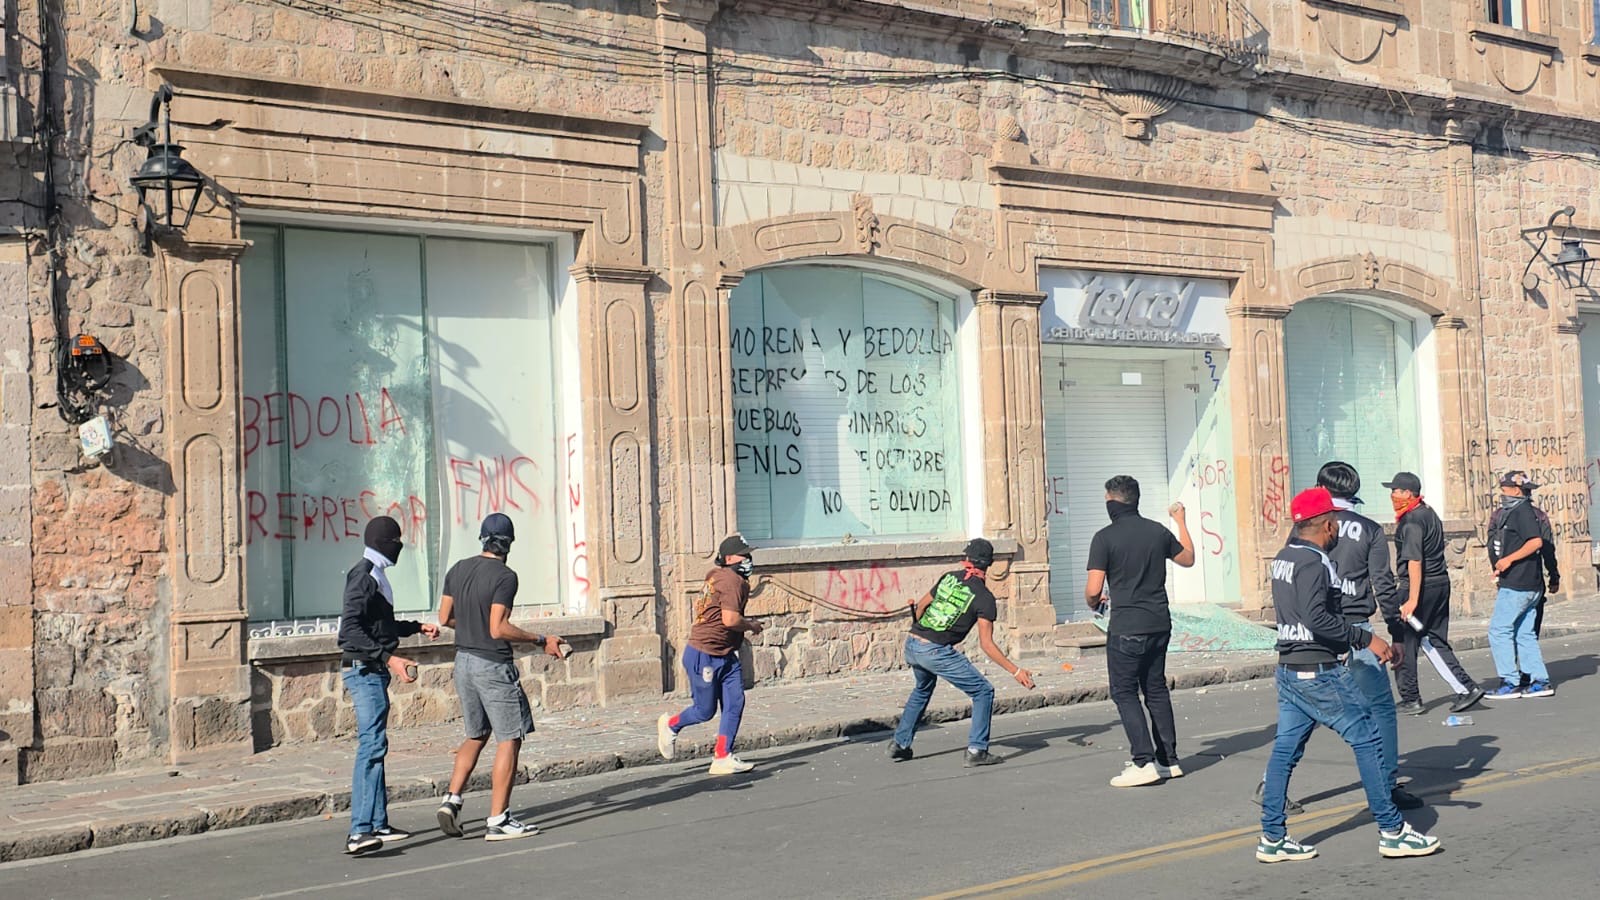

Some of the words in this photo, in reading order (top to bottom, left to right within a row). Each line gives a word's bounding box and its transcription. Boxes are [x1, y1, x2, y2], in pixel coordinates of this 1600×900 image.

[1079, 275, 1195, 328] telcel
[731, 326, 823, 356] MORENA
[839, 328, 851, 356] Y
[864, 327, 953, 358] BEDOLLA
[857, 369, 878, 394] DE
[243, 387, 406, 468] BEDOLLA
[733, 408, 802, 436] UEBLOS
[735, 443, 802, 475] FNLS
[1505, 435, 1568, 458] OCTUBRE
[451, 455, 541, 524] FNLS
[821, 490, 843, 515] NO
[889, 489, 952, 513] OLVIDA
